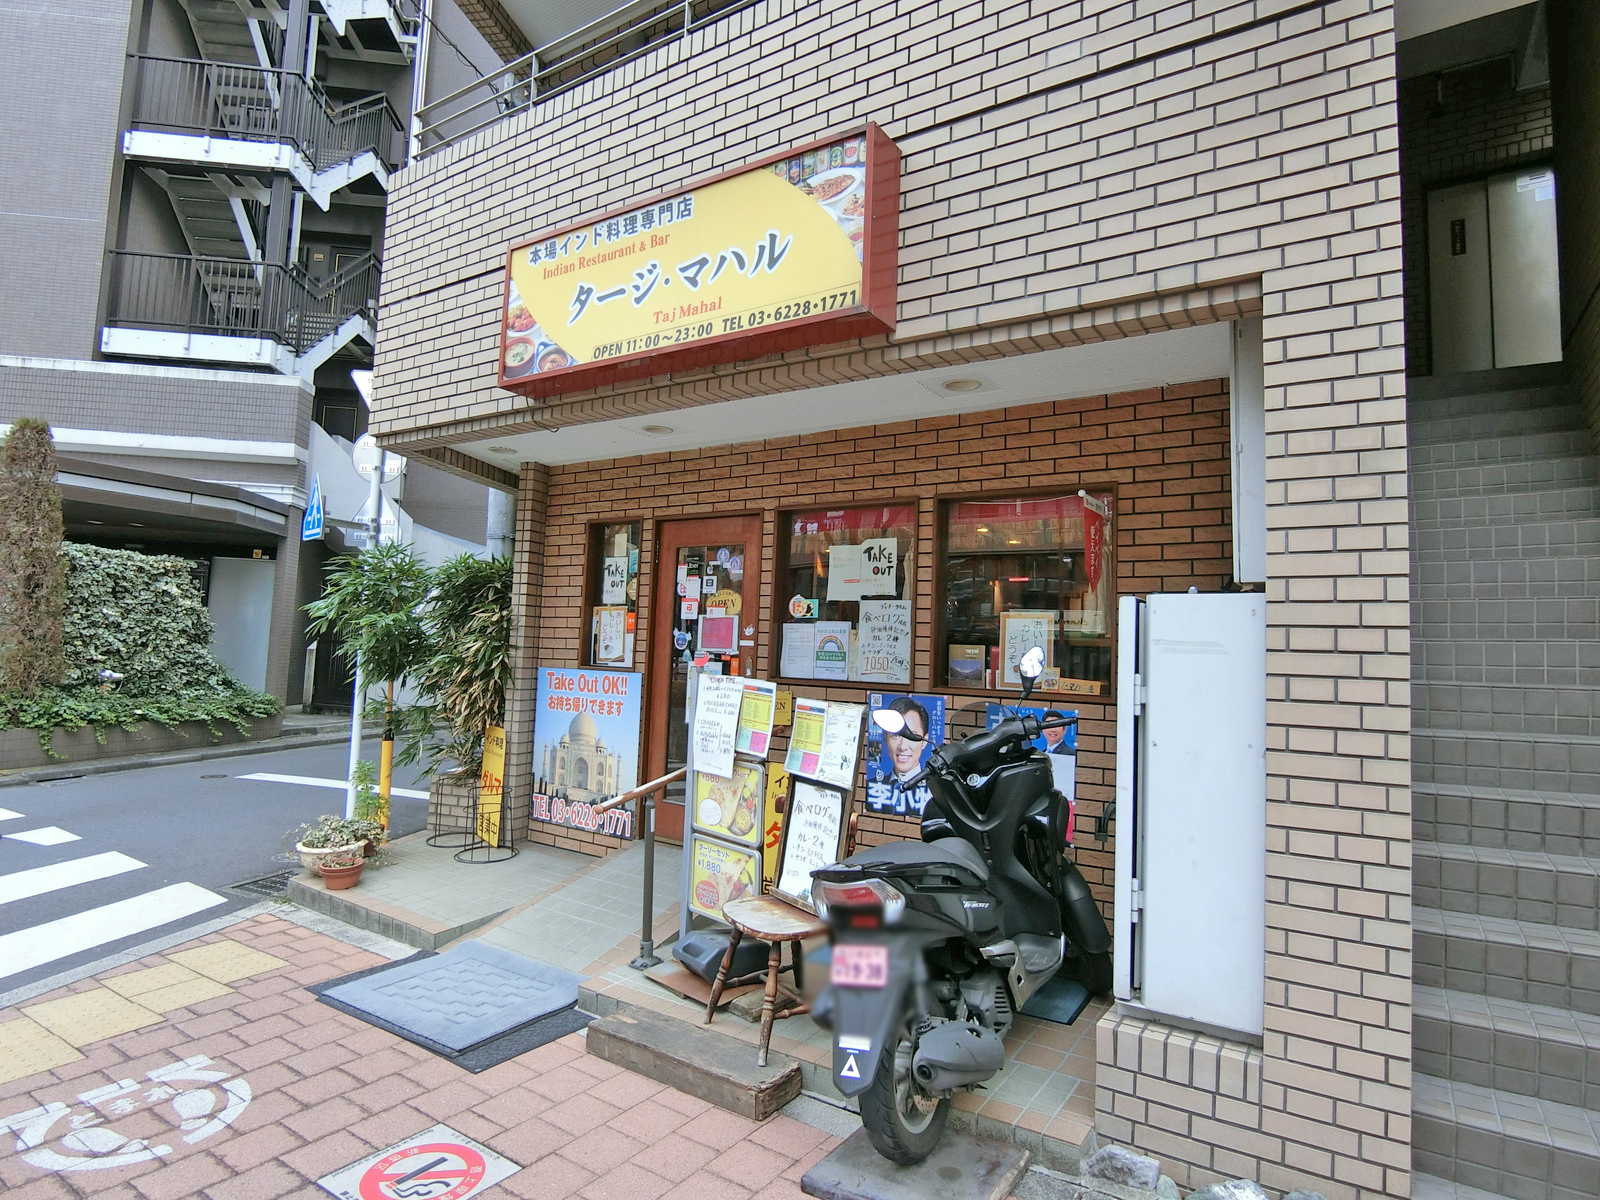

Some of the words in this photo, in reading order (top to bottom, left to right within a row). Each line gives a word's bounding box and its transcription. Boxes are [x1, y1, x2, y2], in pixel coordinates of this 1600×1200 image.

[529, 196, 694, 266] 本場インド料理専門店
[543, 258, 575, 281] Indian
[578, 242, 637, 271] Restaurant
[639, 239, 648, 253] &
[651, 233, 670, 250] Bar
[568, 230, 792, 326] タージ・マハル
[653, 308, 677, 326] Taj
[679, 296, 722, 320] Mahal
[594, 342, 623, 360] OPEN
[722, 315, 744, 333] TEL
[863, 544, 893, 563] TAKE
[604, 561, 624, 579] TAKE
[872, 565, 894, 576] OUT
[610, 580, 624, 589] OUT
[547, 672, 574, 692] Take
[578, 673, 598, 694] Out
[601, 675, 628, 696] OK!!
[547, 695, 624, 717] お持ち帰りできます
[481, 770, 502, 795] ダルマ
[533, 794, 550, 820] TEL
